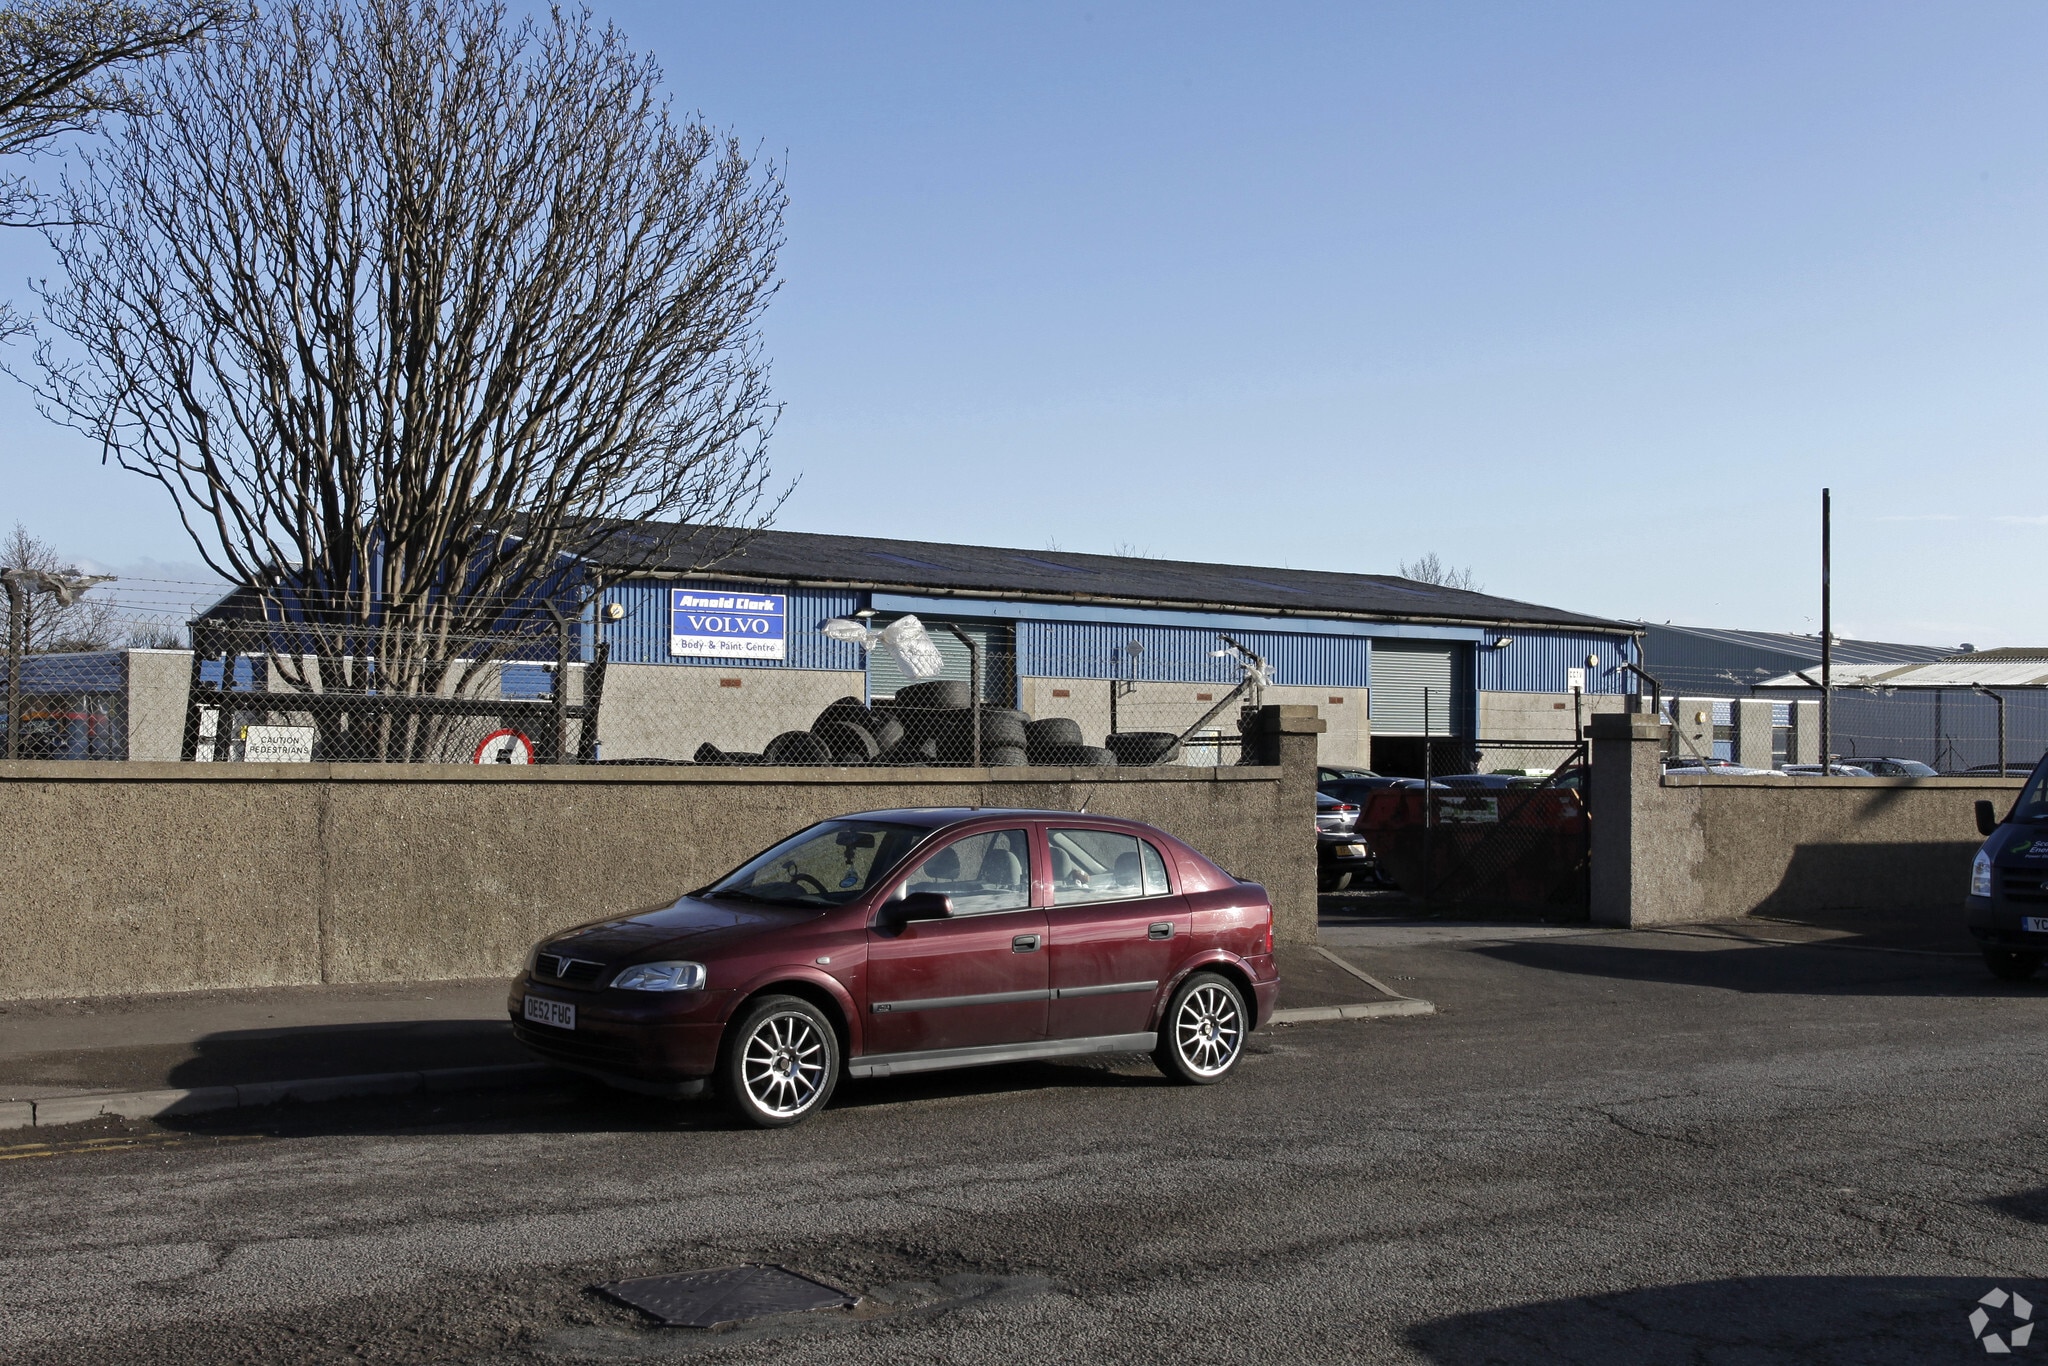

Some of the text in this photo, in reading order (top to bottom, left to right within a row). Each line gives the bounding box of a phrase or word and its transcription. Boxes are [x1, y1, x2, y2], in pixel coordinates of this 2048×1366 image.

[679, 595, 775, 611] Arnold Clark
[687, 615, 769, 634] VOLVO
[681, 640, 775, 652] Body & Paint Centre
[260, 736, 300, 744] CAUTION
[249, 746, 309, 754] PEDESTRIANS
